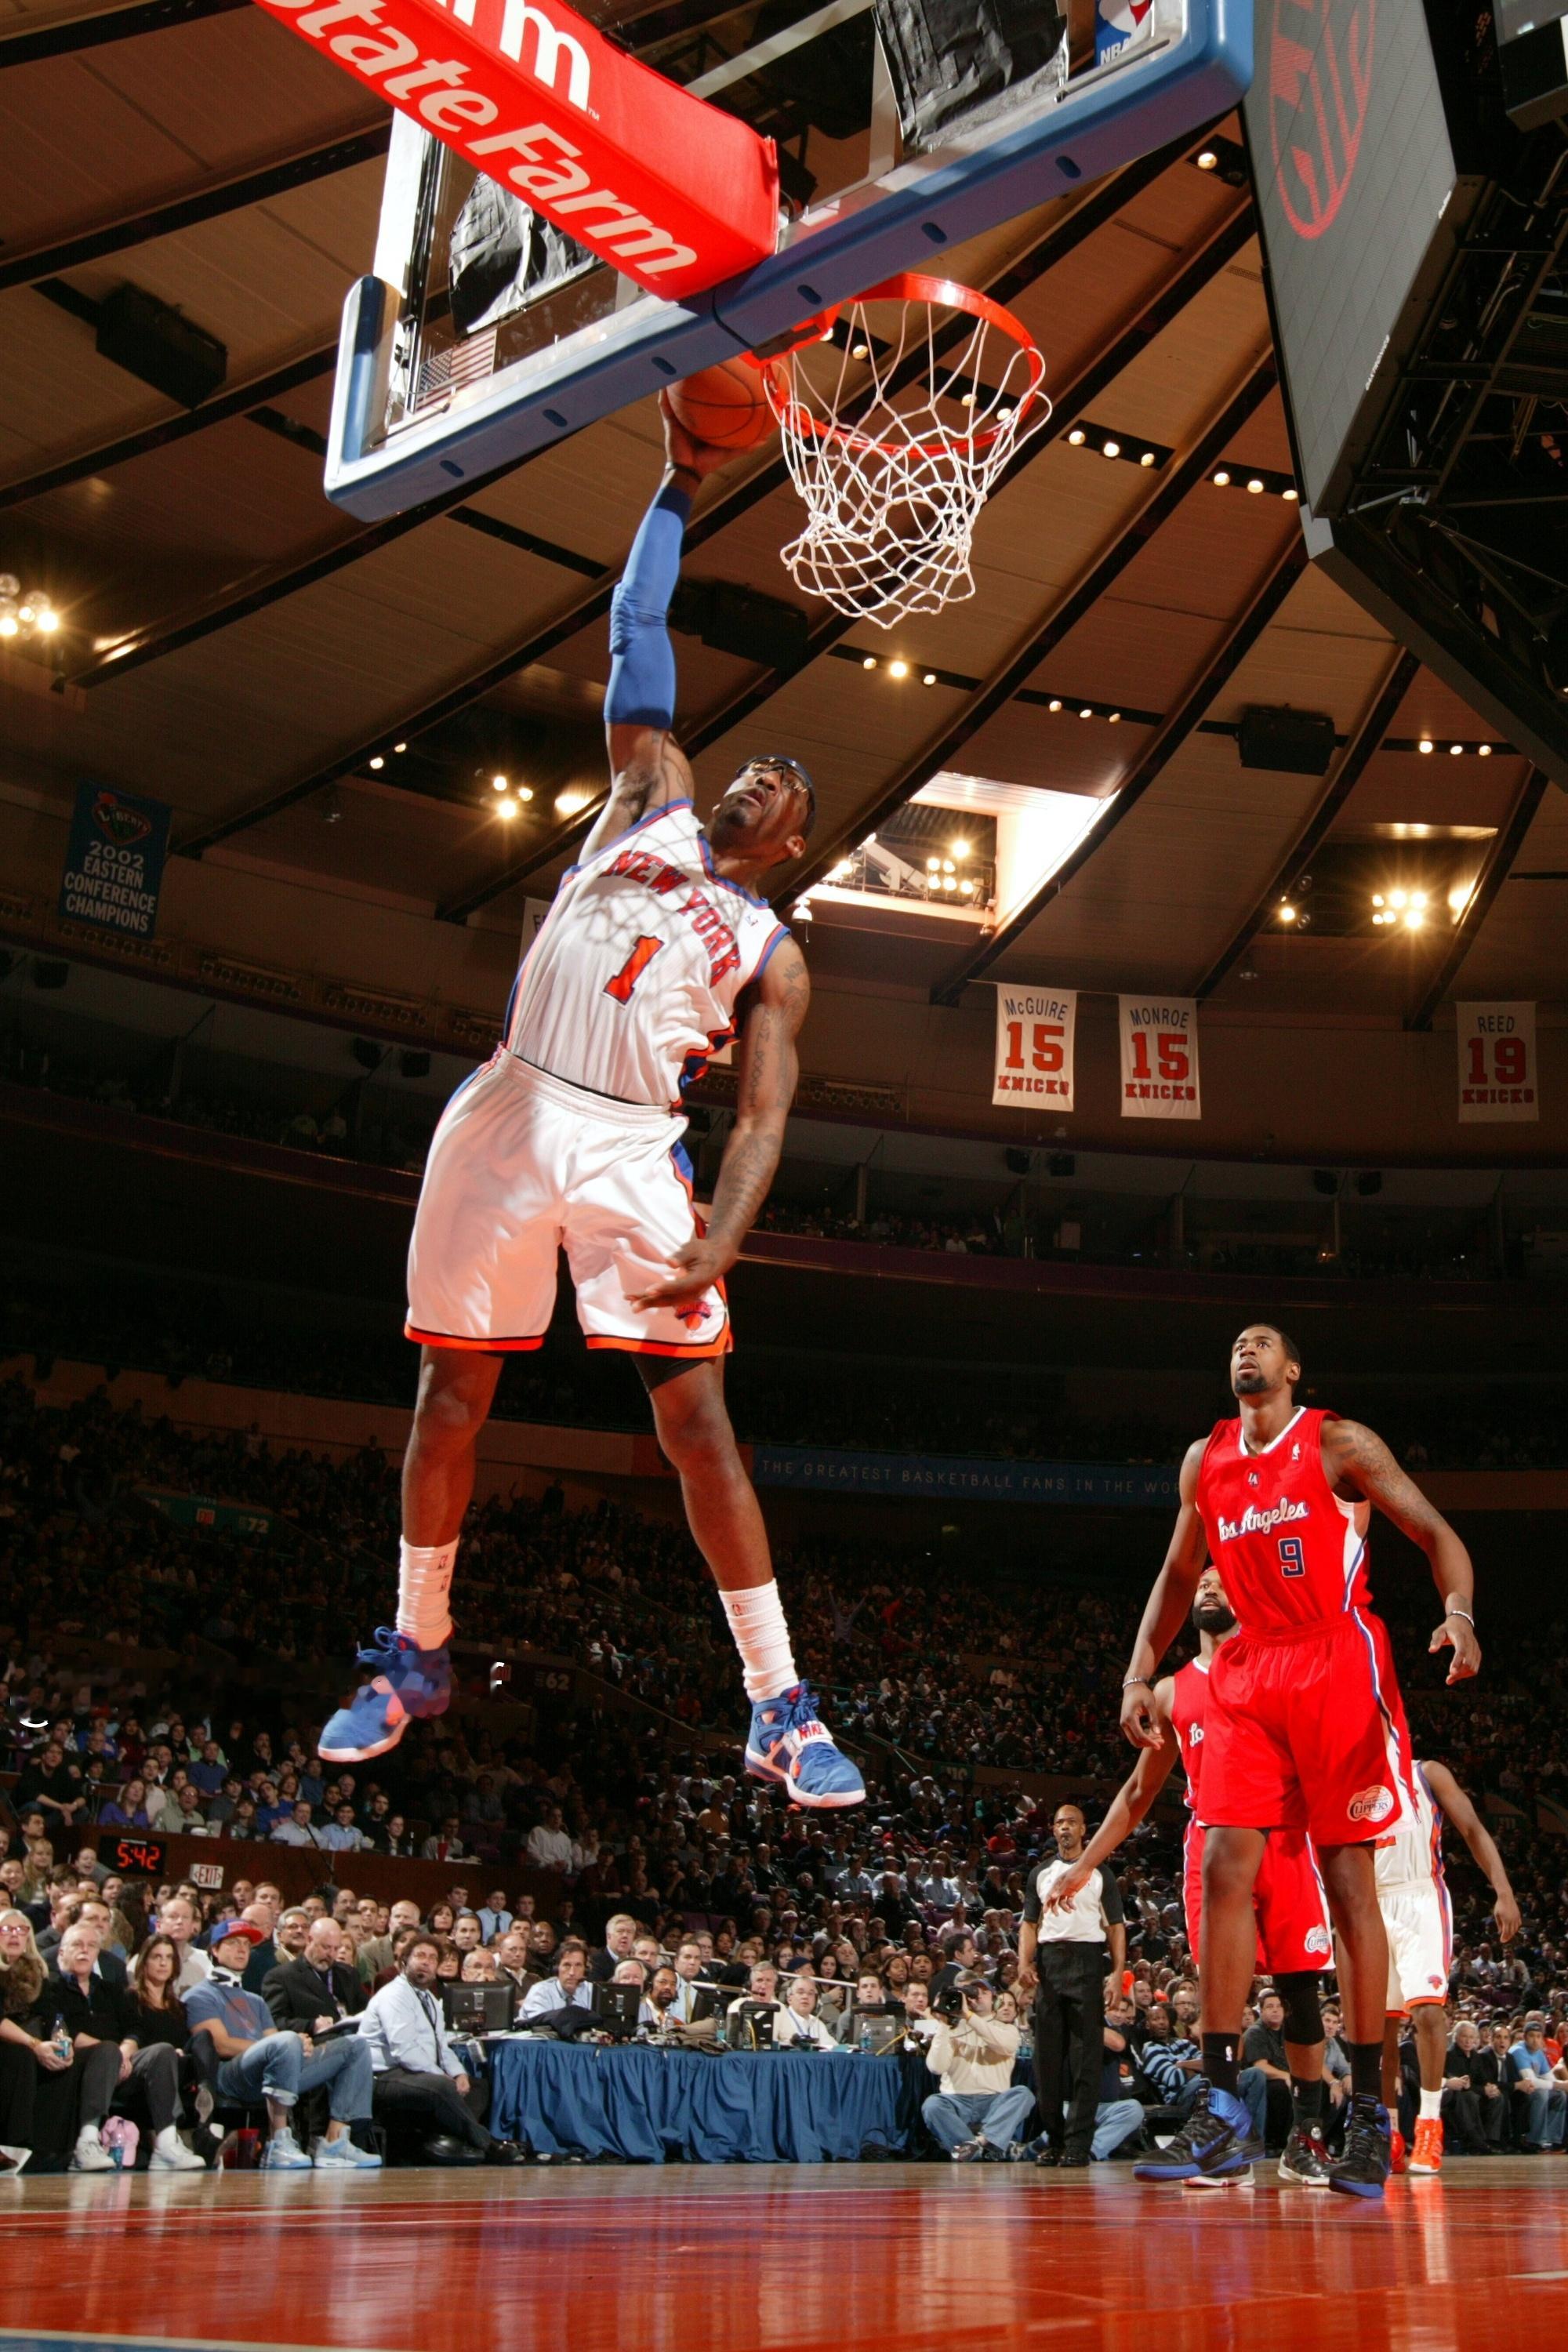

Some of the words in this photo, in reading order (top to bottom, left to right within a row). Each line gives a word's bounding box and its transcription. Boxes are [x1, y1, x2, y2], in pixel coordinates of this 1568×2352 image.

[261, 0, 499, 132] tate
[465, 122, 698, 274] Farm
[89, 840, 144, 869] 2002
[83, 855, 144, 889] EASTERN
[598, 850, 690, 895] NEW
[64, 871, 157, 913] CONFERENCE
[66, 893, 150, 932] CHAMPIONS
[676, 887, 741, 989] YORK
[603, 935, 665, 1007] 1
[1004, 996, 1068, 1021] McGUIRE
[1130, 1007, 1189, 1029] MONROE
[1477, 1016, 1515, 1033] REED
[1005, 1021, 1065, 1073] 15
[1131, 1032, 1189, 1080] 15
[1468, 1037, 1526, 1084] 19
[997, 1075, 1069, 1096] KNICKS
[1125, 1083, 1196, 1101] KNICKS
[1462, 1088, 1534, 1104] KNICKS
[763, 1460, 793, 1474] THE
[804, 1463, 891, 1480] GREATEST
[902, 1470, 1013, 1488] BASKETBALL
[1022, 1476, 1065, 1490] FANS
[1076, 1479, 1093, 1491] IN
[1104, 1480, 1134, 1493] THE
[1218, 1516, 1239, 1542] Los
[1240, 1497, 1308, 1534] Angeles
[1278, 1537, 1305, 1577] 9
[546, 1672, 570, 1691] 62
[1189, 1722, 1205, 1748] Lo
[117, 1843, 162, 1871] 5:42
[198, 1865, 219, 1886] EXIT
